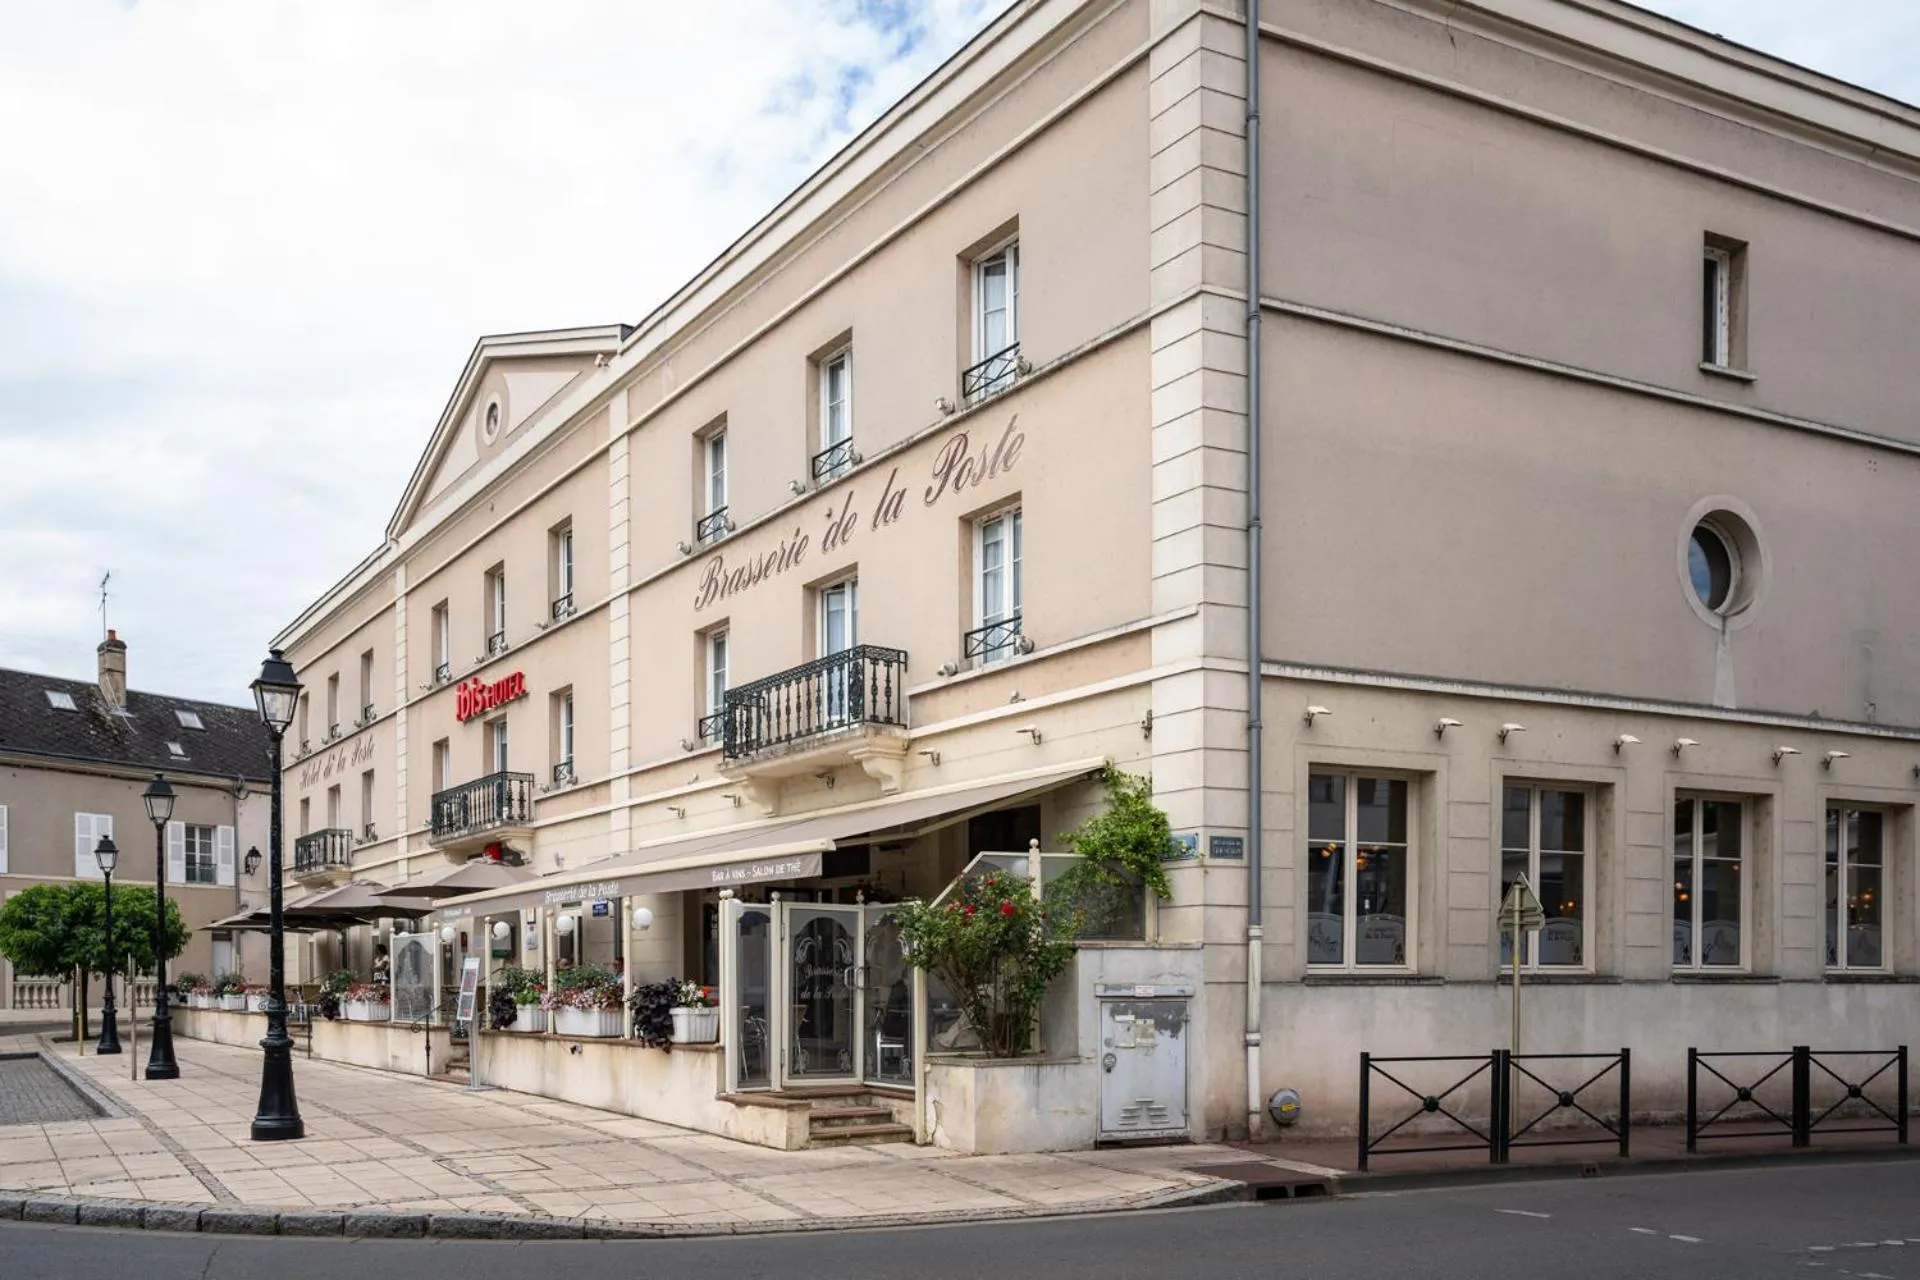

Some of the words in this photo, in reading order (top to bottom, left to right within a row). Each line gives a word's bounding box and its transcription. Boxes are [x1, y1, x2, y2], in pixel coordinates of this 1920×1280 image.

[694, 527, 809, 611] Brasserie
[821, 490, 858, 555] de
[871, 467, 907, 532] la
[924, 413, 1026, 507] Poste
[456, 678, 486, 722] ibis
[337, 747, 346, 773] la
[351, 734, 376, 767] Poste
[731, 867, 746, 880] VINS
[752, 863, 774, 878] SALON
[775, 863, 785, 875] DE
[786, 858, 802, 874] THÉ
[578, 885, 588, 898] de
[588, 884, 597, 897] la
[598, 881, 619, 896] Poste
